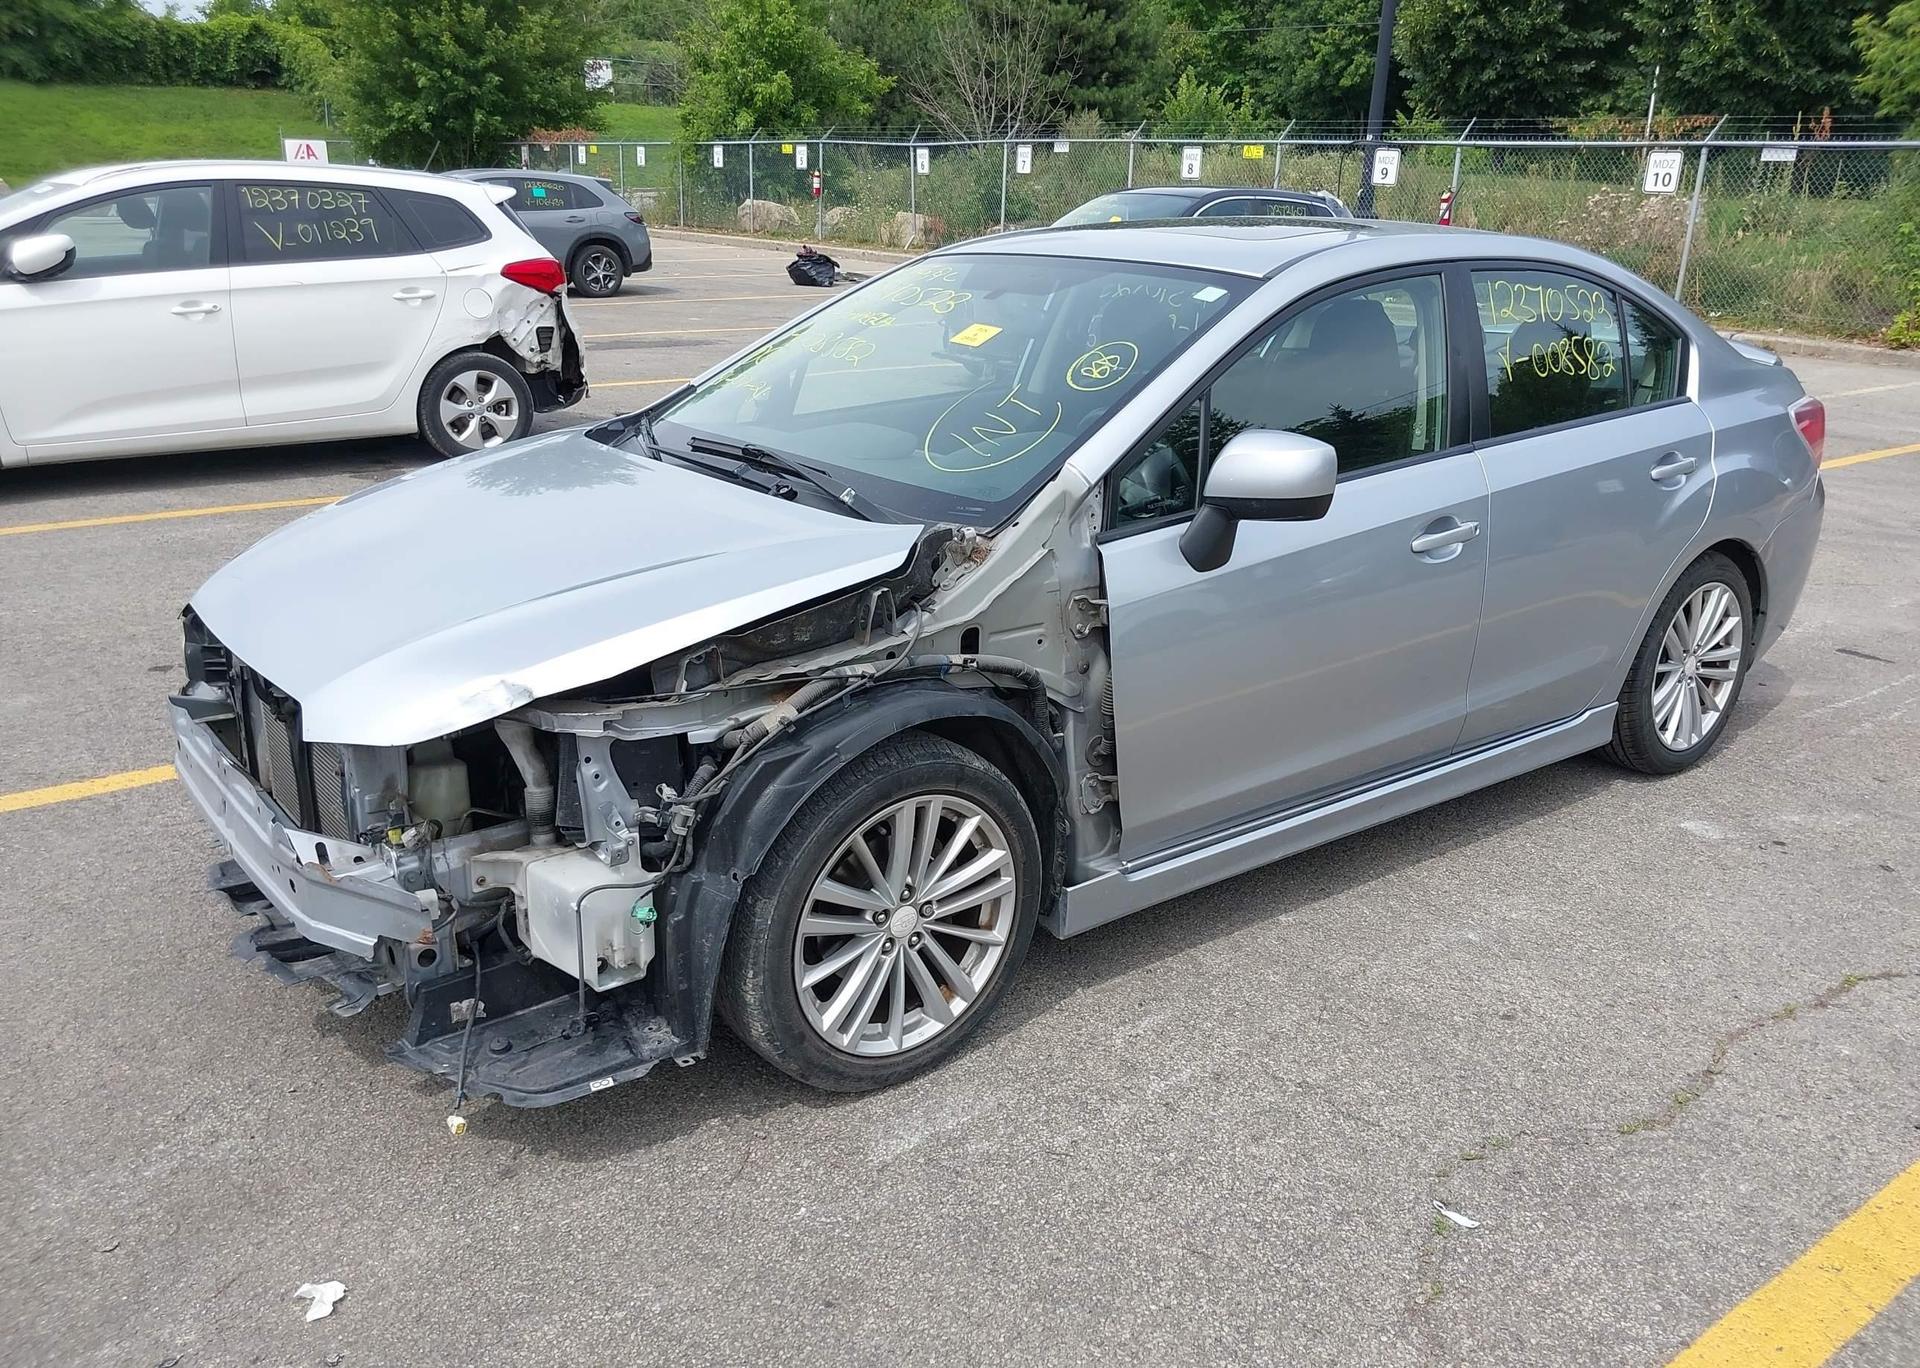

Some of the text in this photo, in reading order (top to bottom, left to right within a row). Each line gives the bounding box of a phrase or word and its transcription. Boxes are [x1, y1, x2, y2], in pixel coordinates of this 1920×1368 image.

[1378, 156, 1396, 165] MDZ
[1652, 159, 1676, 169] MDZ
[1187, 163, 1194, 175] 8
[1380, 167, 1389, 180] 9
[1652, 172, 1672, 188] 10
[241, 186, 370, 216] 12370327
[1488, 280, 1614, 329] 12370523
[1498, 336, 1616, 382] V-008582
[950, 383, 1042, 457] INT
